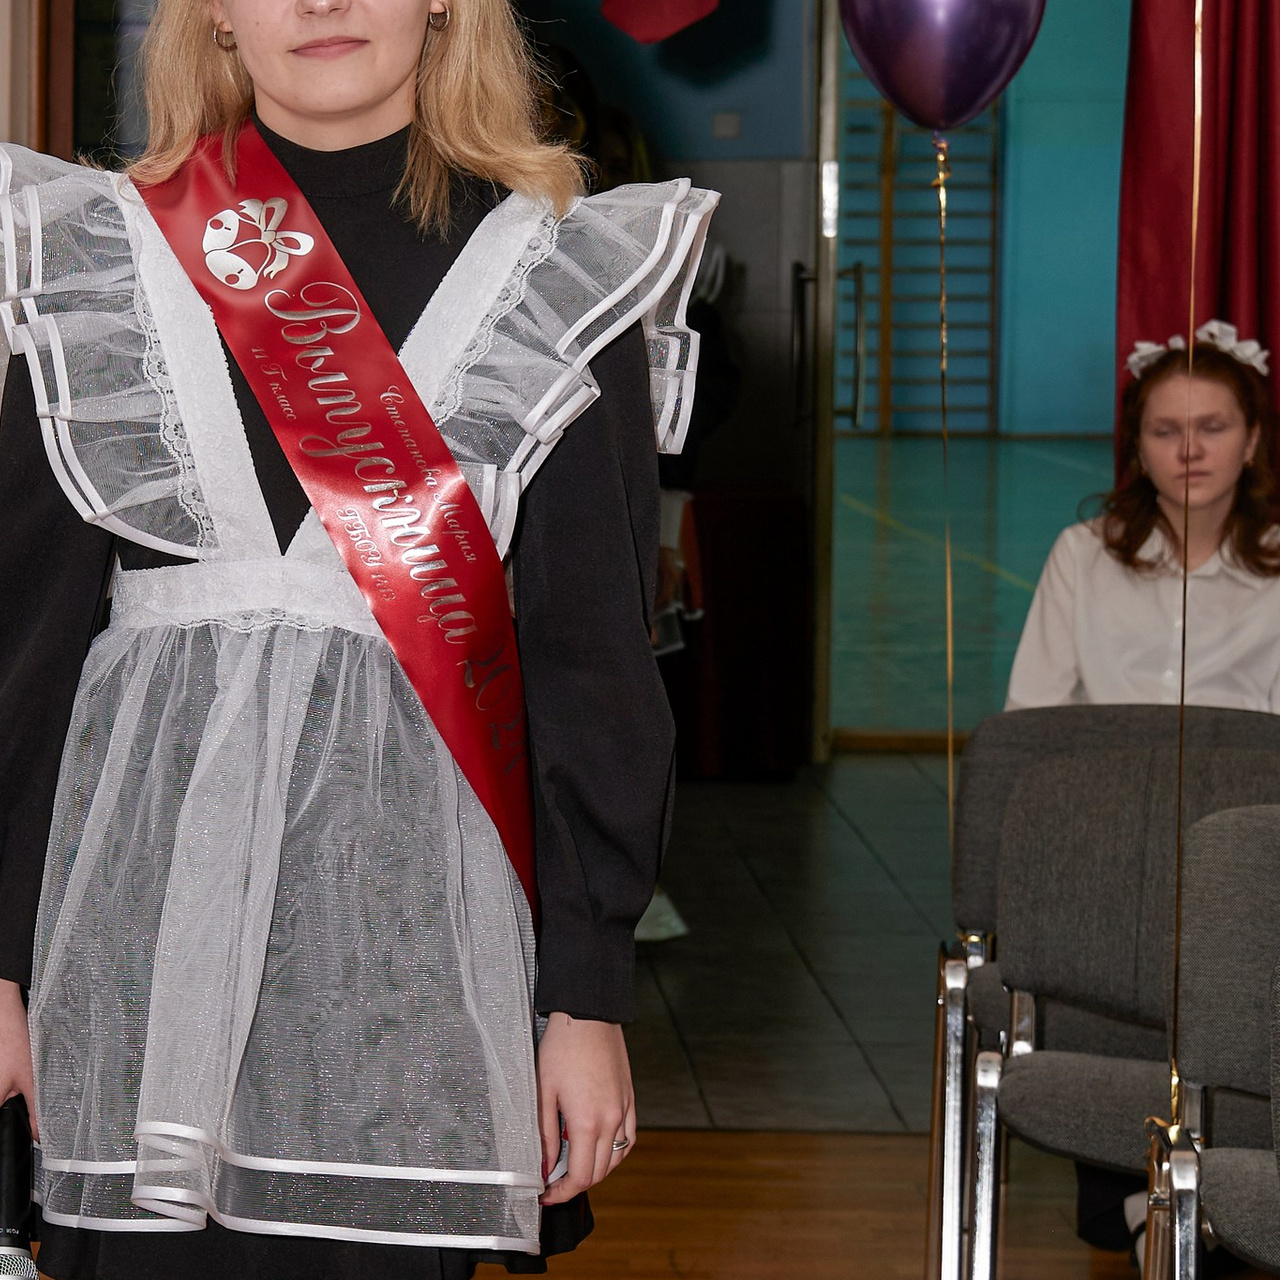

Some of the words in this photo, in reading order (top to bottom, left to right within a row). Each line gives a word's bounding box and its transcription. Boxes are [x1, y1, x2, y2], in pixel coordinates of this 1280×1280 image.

[251, 346, 269, 360] 11
[269, 382, 297, 421] класс
[263, 281, 478, 645] Выпускница
[380, 385, 441, 488] Степанова
[433, 493, 477, 564] Мария
[336, 507, 385, 568] ГБОУ
